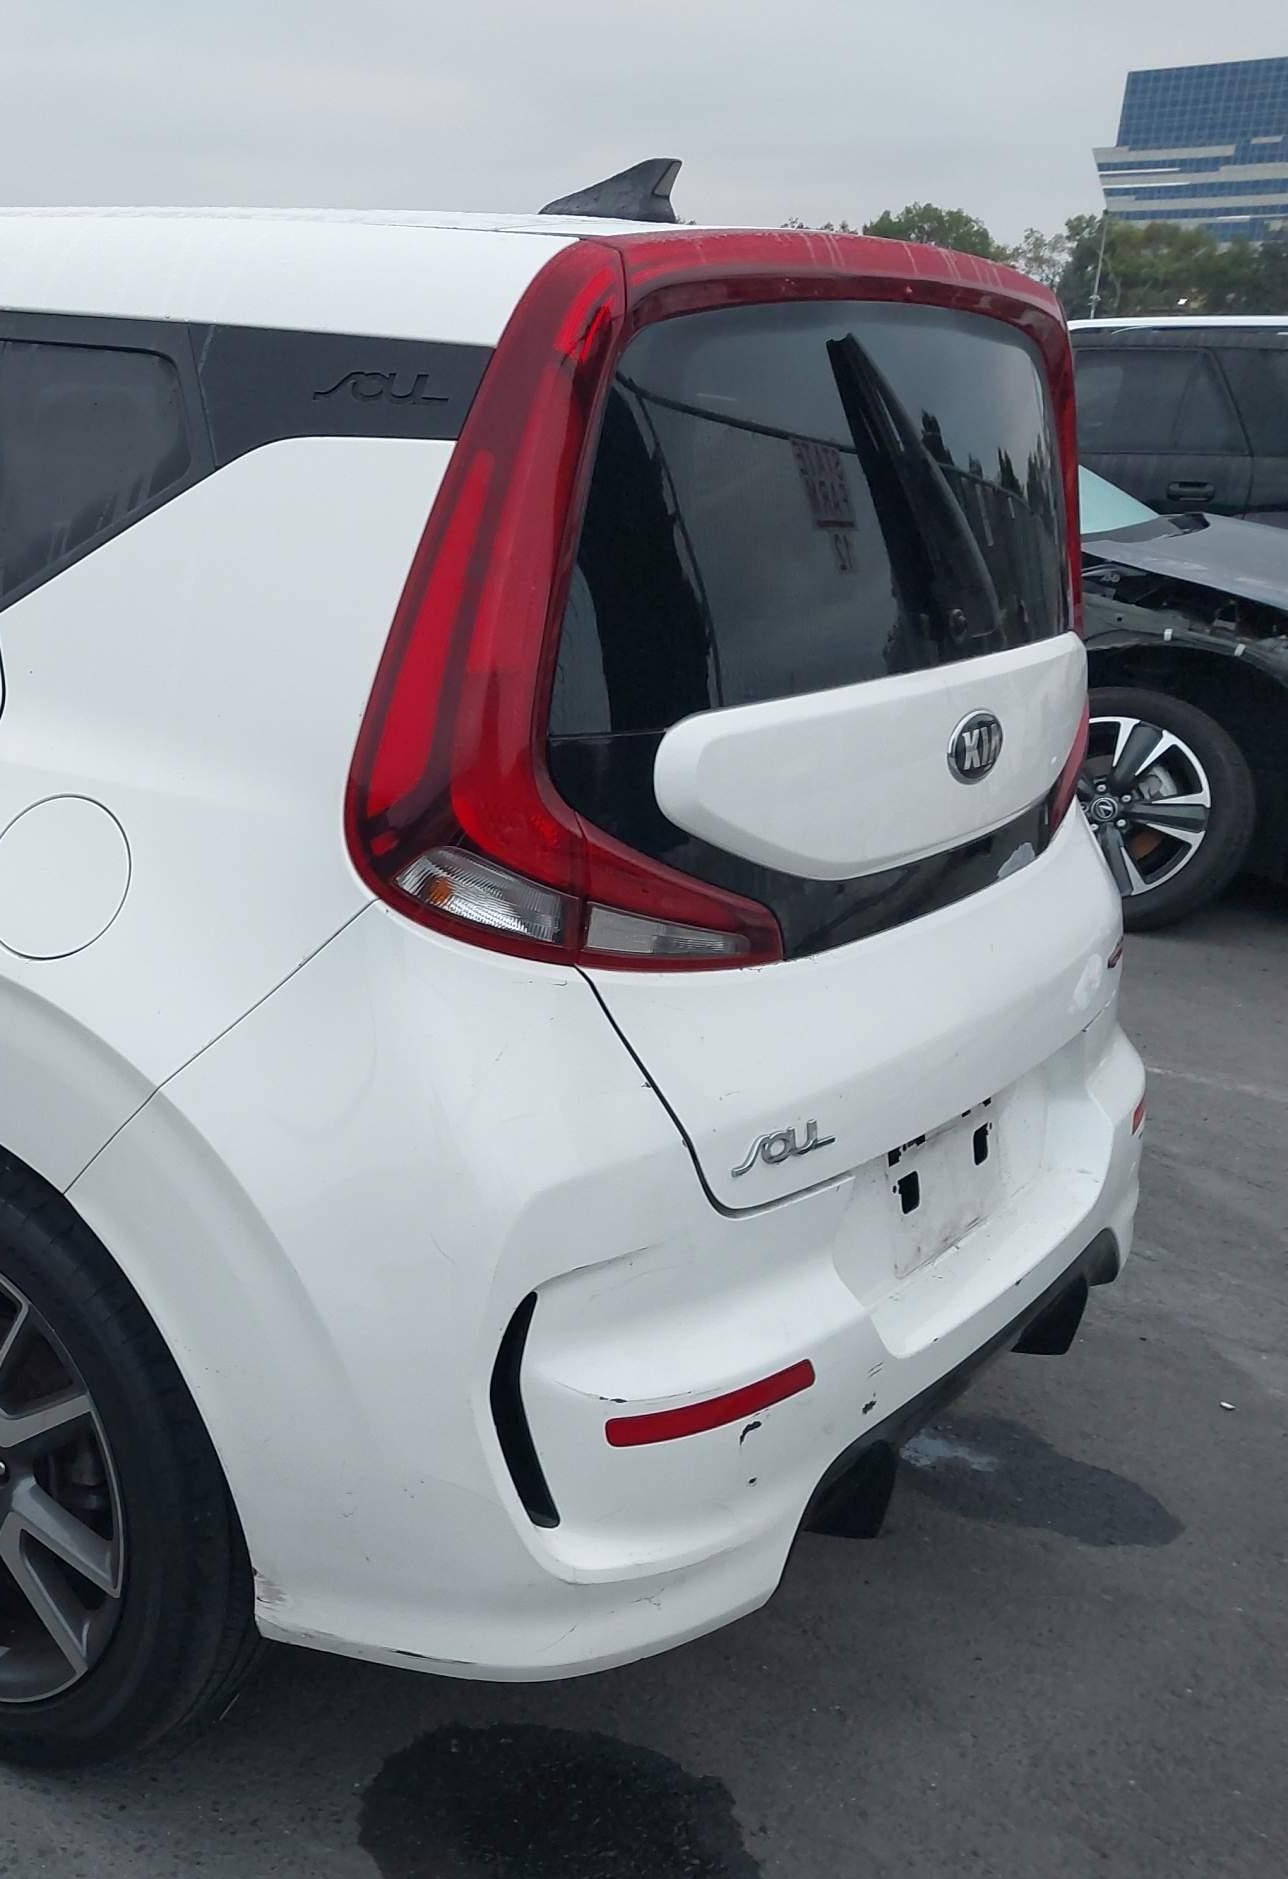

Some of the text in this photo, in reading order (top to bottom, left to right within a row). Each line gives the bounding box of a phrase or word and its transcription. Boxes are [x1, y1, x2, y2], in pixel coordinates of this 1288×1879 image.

[312, 371, 449, 404] SOUL
[962, 723, 1000, 770] KIA
[731, 1119, 835, 1177] SOUL
